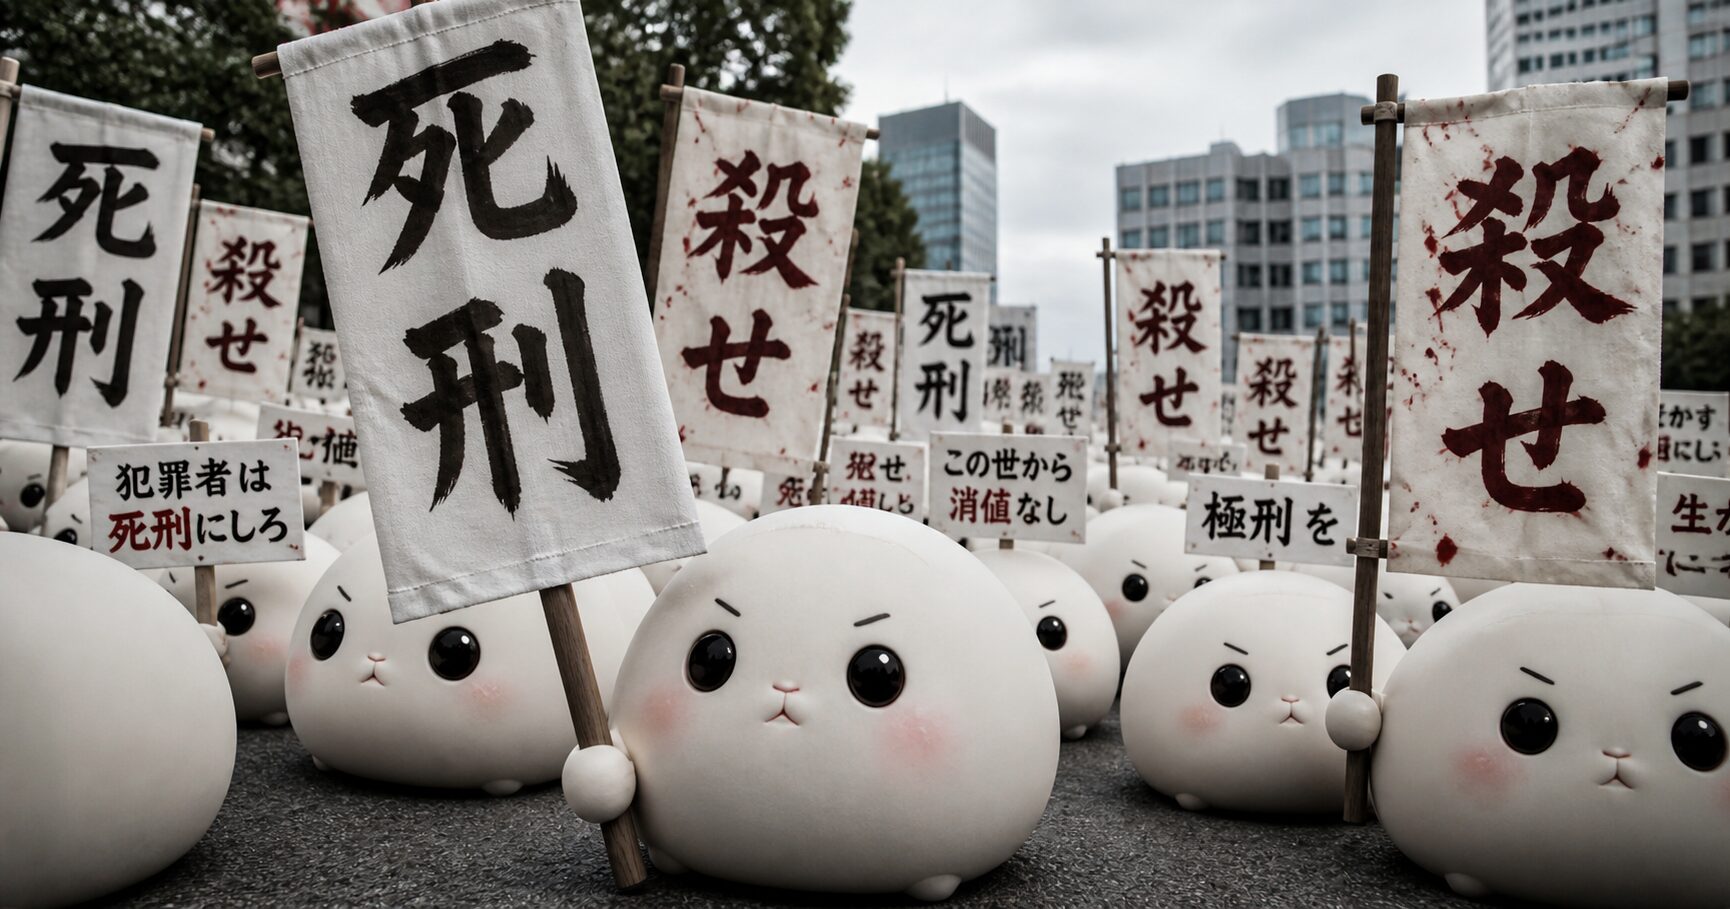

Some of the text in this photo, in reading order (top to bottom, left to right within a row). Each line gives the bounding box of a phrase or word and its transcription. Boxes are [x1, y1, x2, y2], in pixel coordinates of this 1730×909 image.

[13, 142, 160, 408] 死刑
[206, 236, 283, 374] 殺せ
[350, 39, 621, 521] 死刑
[681, 150, 820, 418] 殺せ
[1435, 146, 1638, 513] 殺せ
[848, 331, 885, 409] 殺せ
[914, 292, 975, 423] 死刑
[1133, 281, 1208, 427] 殺せ
[1247, 357, 1298, 455] 殺せ
[115, 458, 272, 501] 犯罪者は
[944, 448, 1072, 482] この世から
[949, 486, 1067, 525] 消値なし
[1201, 491, 1339, 547] 極刑を
[108, 506, 289, 554] 死刑にしろ
